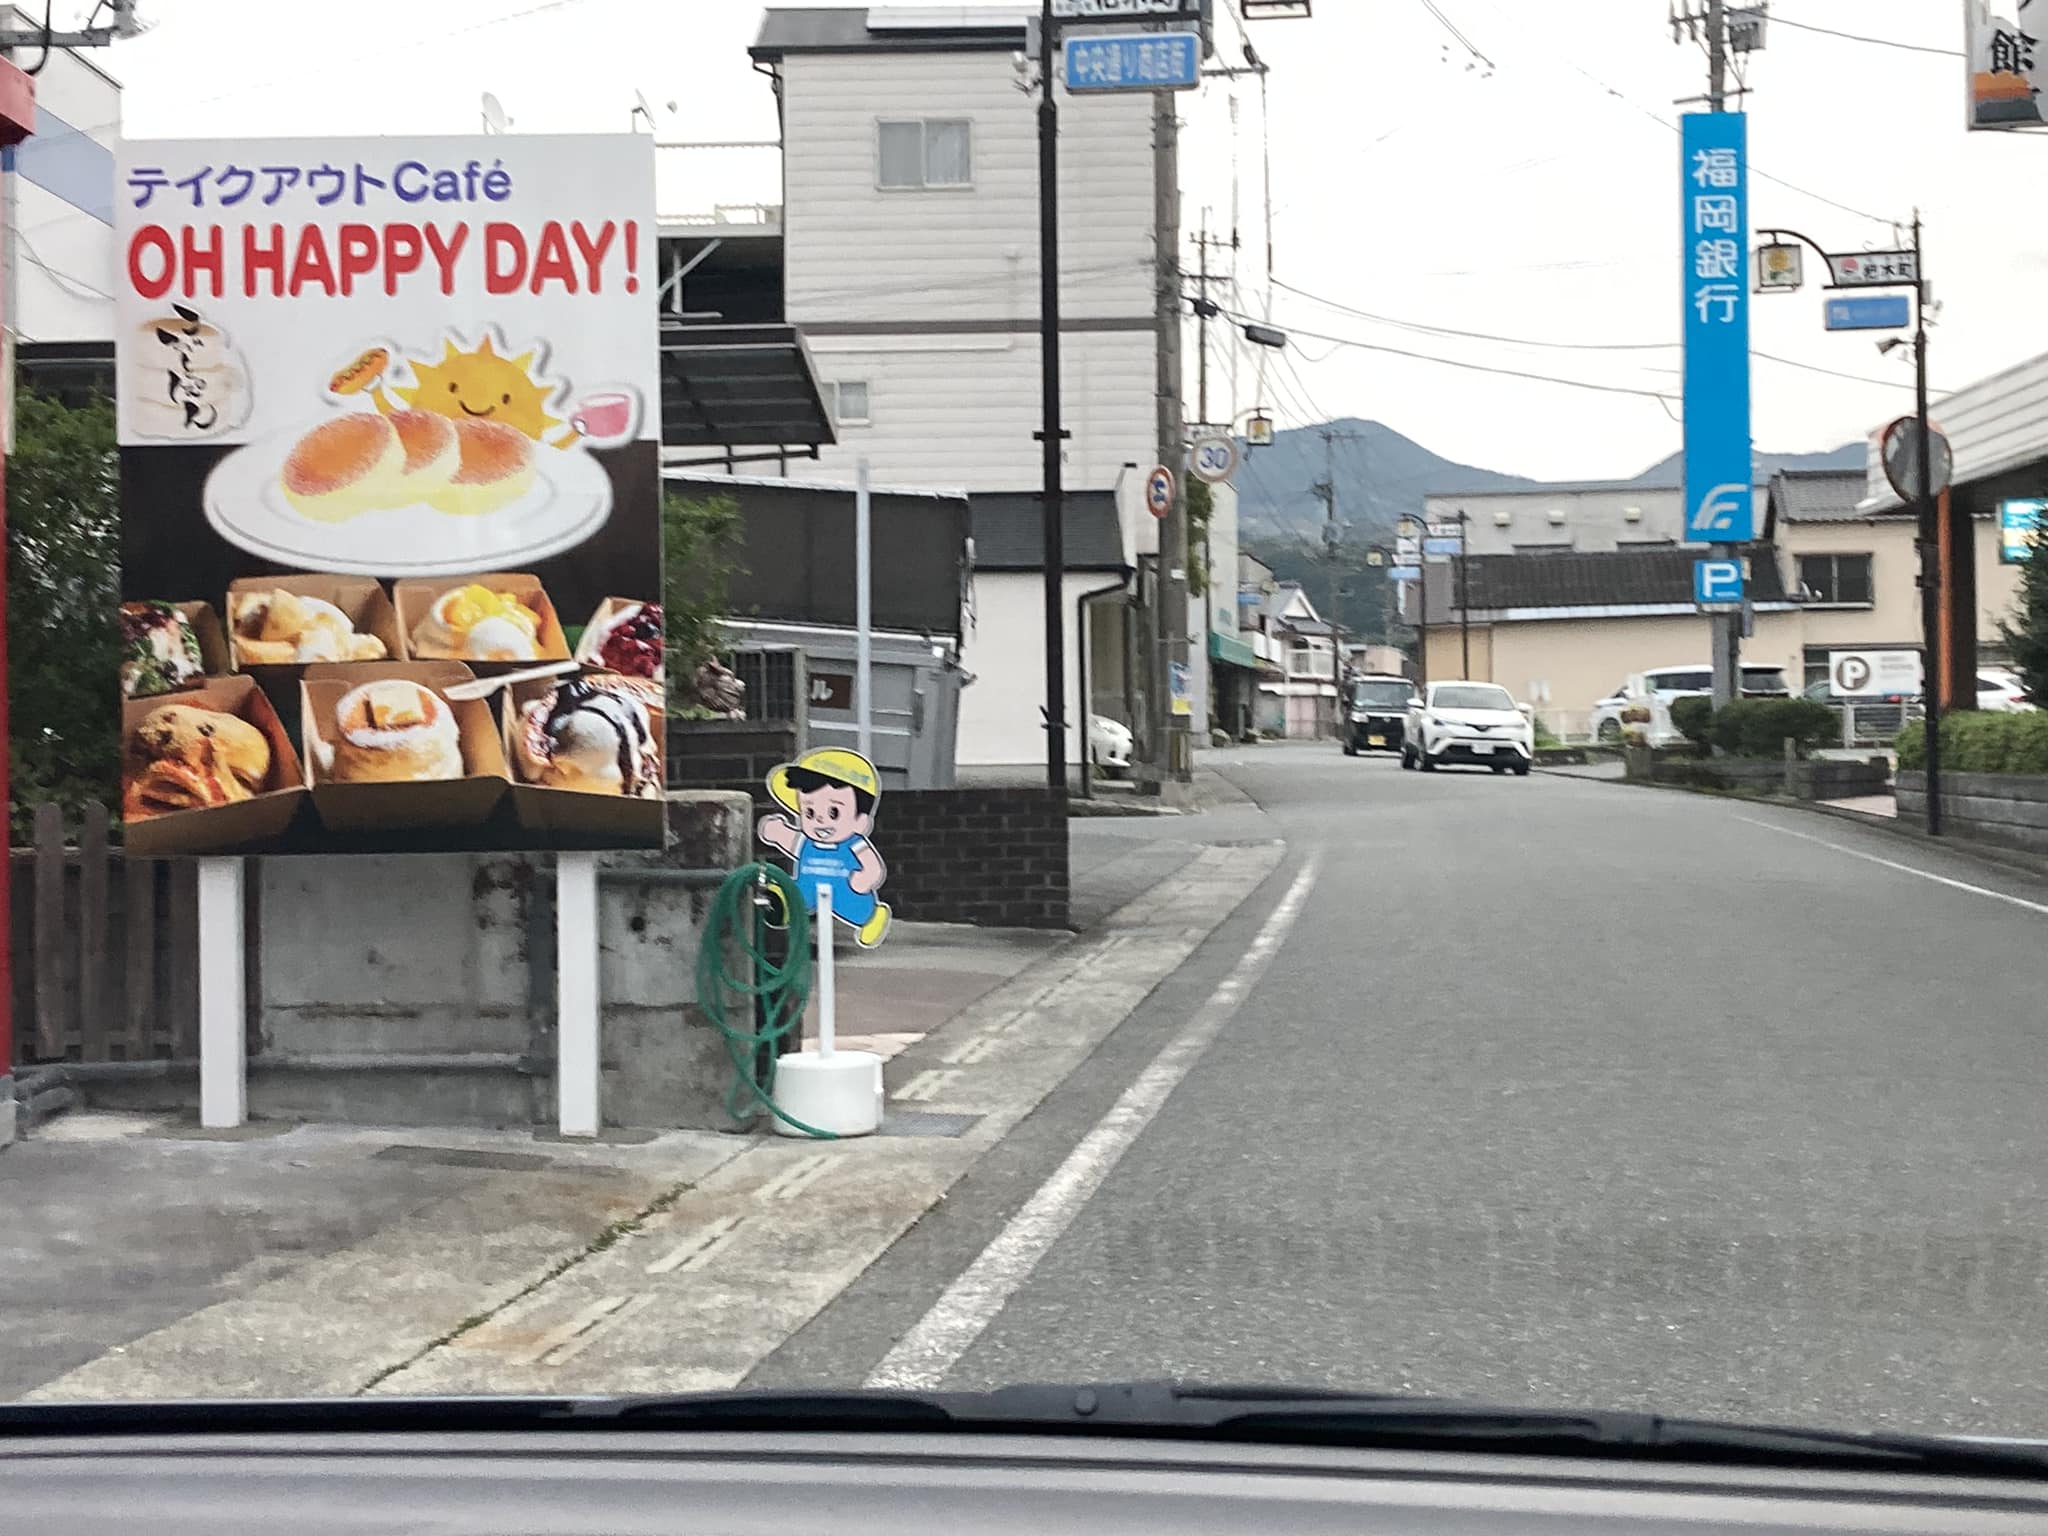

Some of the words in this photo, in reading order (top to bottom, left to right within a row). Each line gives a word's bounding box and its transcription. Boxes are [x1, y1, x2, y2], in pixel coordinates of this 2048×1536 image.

[126, 157, 512, 208] テイクアウトCafé
[1691, 147, 1738, 324] 福岡銀行
[127, 222, 225, 299] OH
[242, 221, 468, 298] HAPPY
[484, 219, 640, 295] DAY!
[1200, 447, 1230, 470] 30
[1702, 562, 1738, 598] P
[1842, 663, 1866, 687] P
